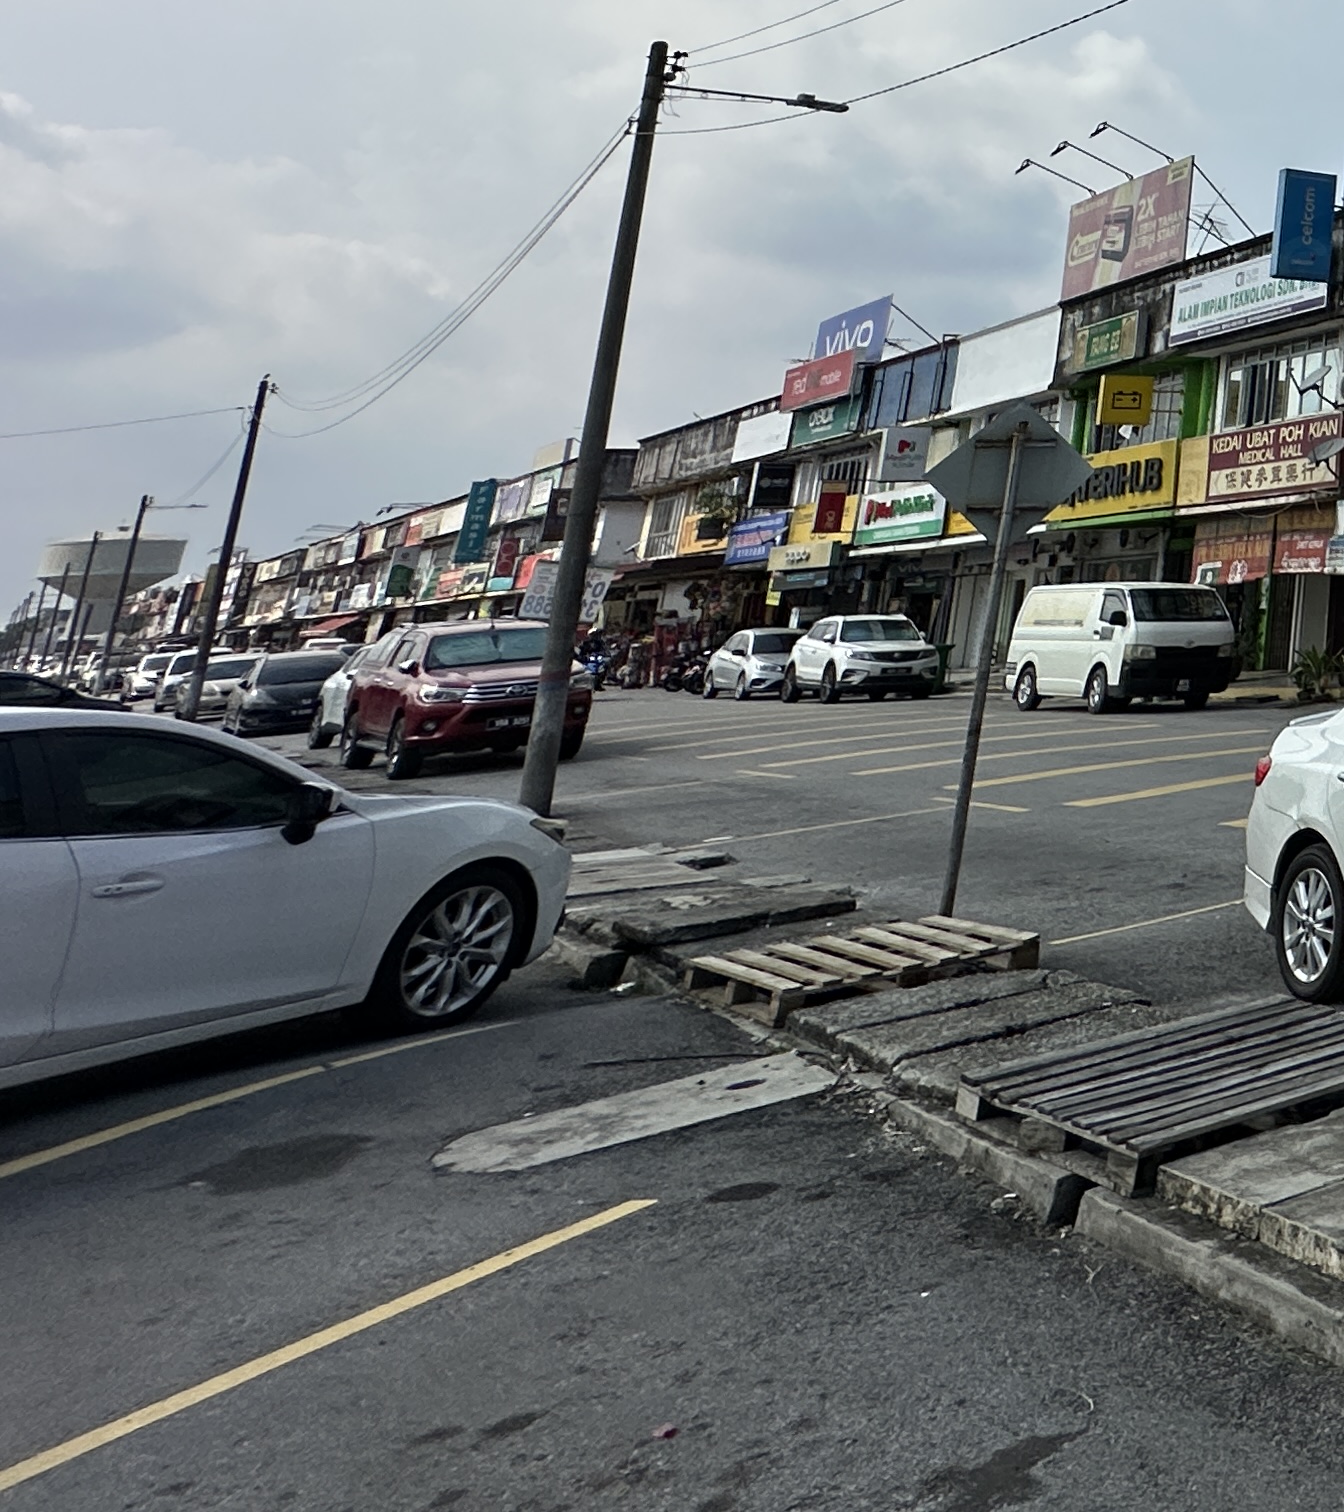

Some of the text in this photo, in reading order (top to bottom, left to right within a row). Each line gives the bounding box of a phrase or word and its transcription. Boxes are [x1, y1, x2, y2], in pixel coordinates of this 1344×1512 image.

[1301, 187, 1316, 245] celcom
[1177, 303, 1199, 324] ALAM
[1200, 296, 1229, 317] IMPIAN
[1229, 280, 1276, 310] TEKNOLOGI
[825, 319, 875, 356] vivo
[1212, 419, 1339, 454] KEDAI UBAT POH KIAN
[1238, 444, 1303, 465] MEDICAL HALL
